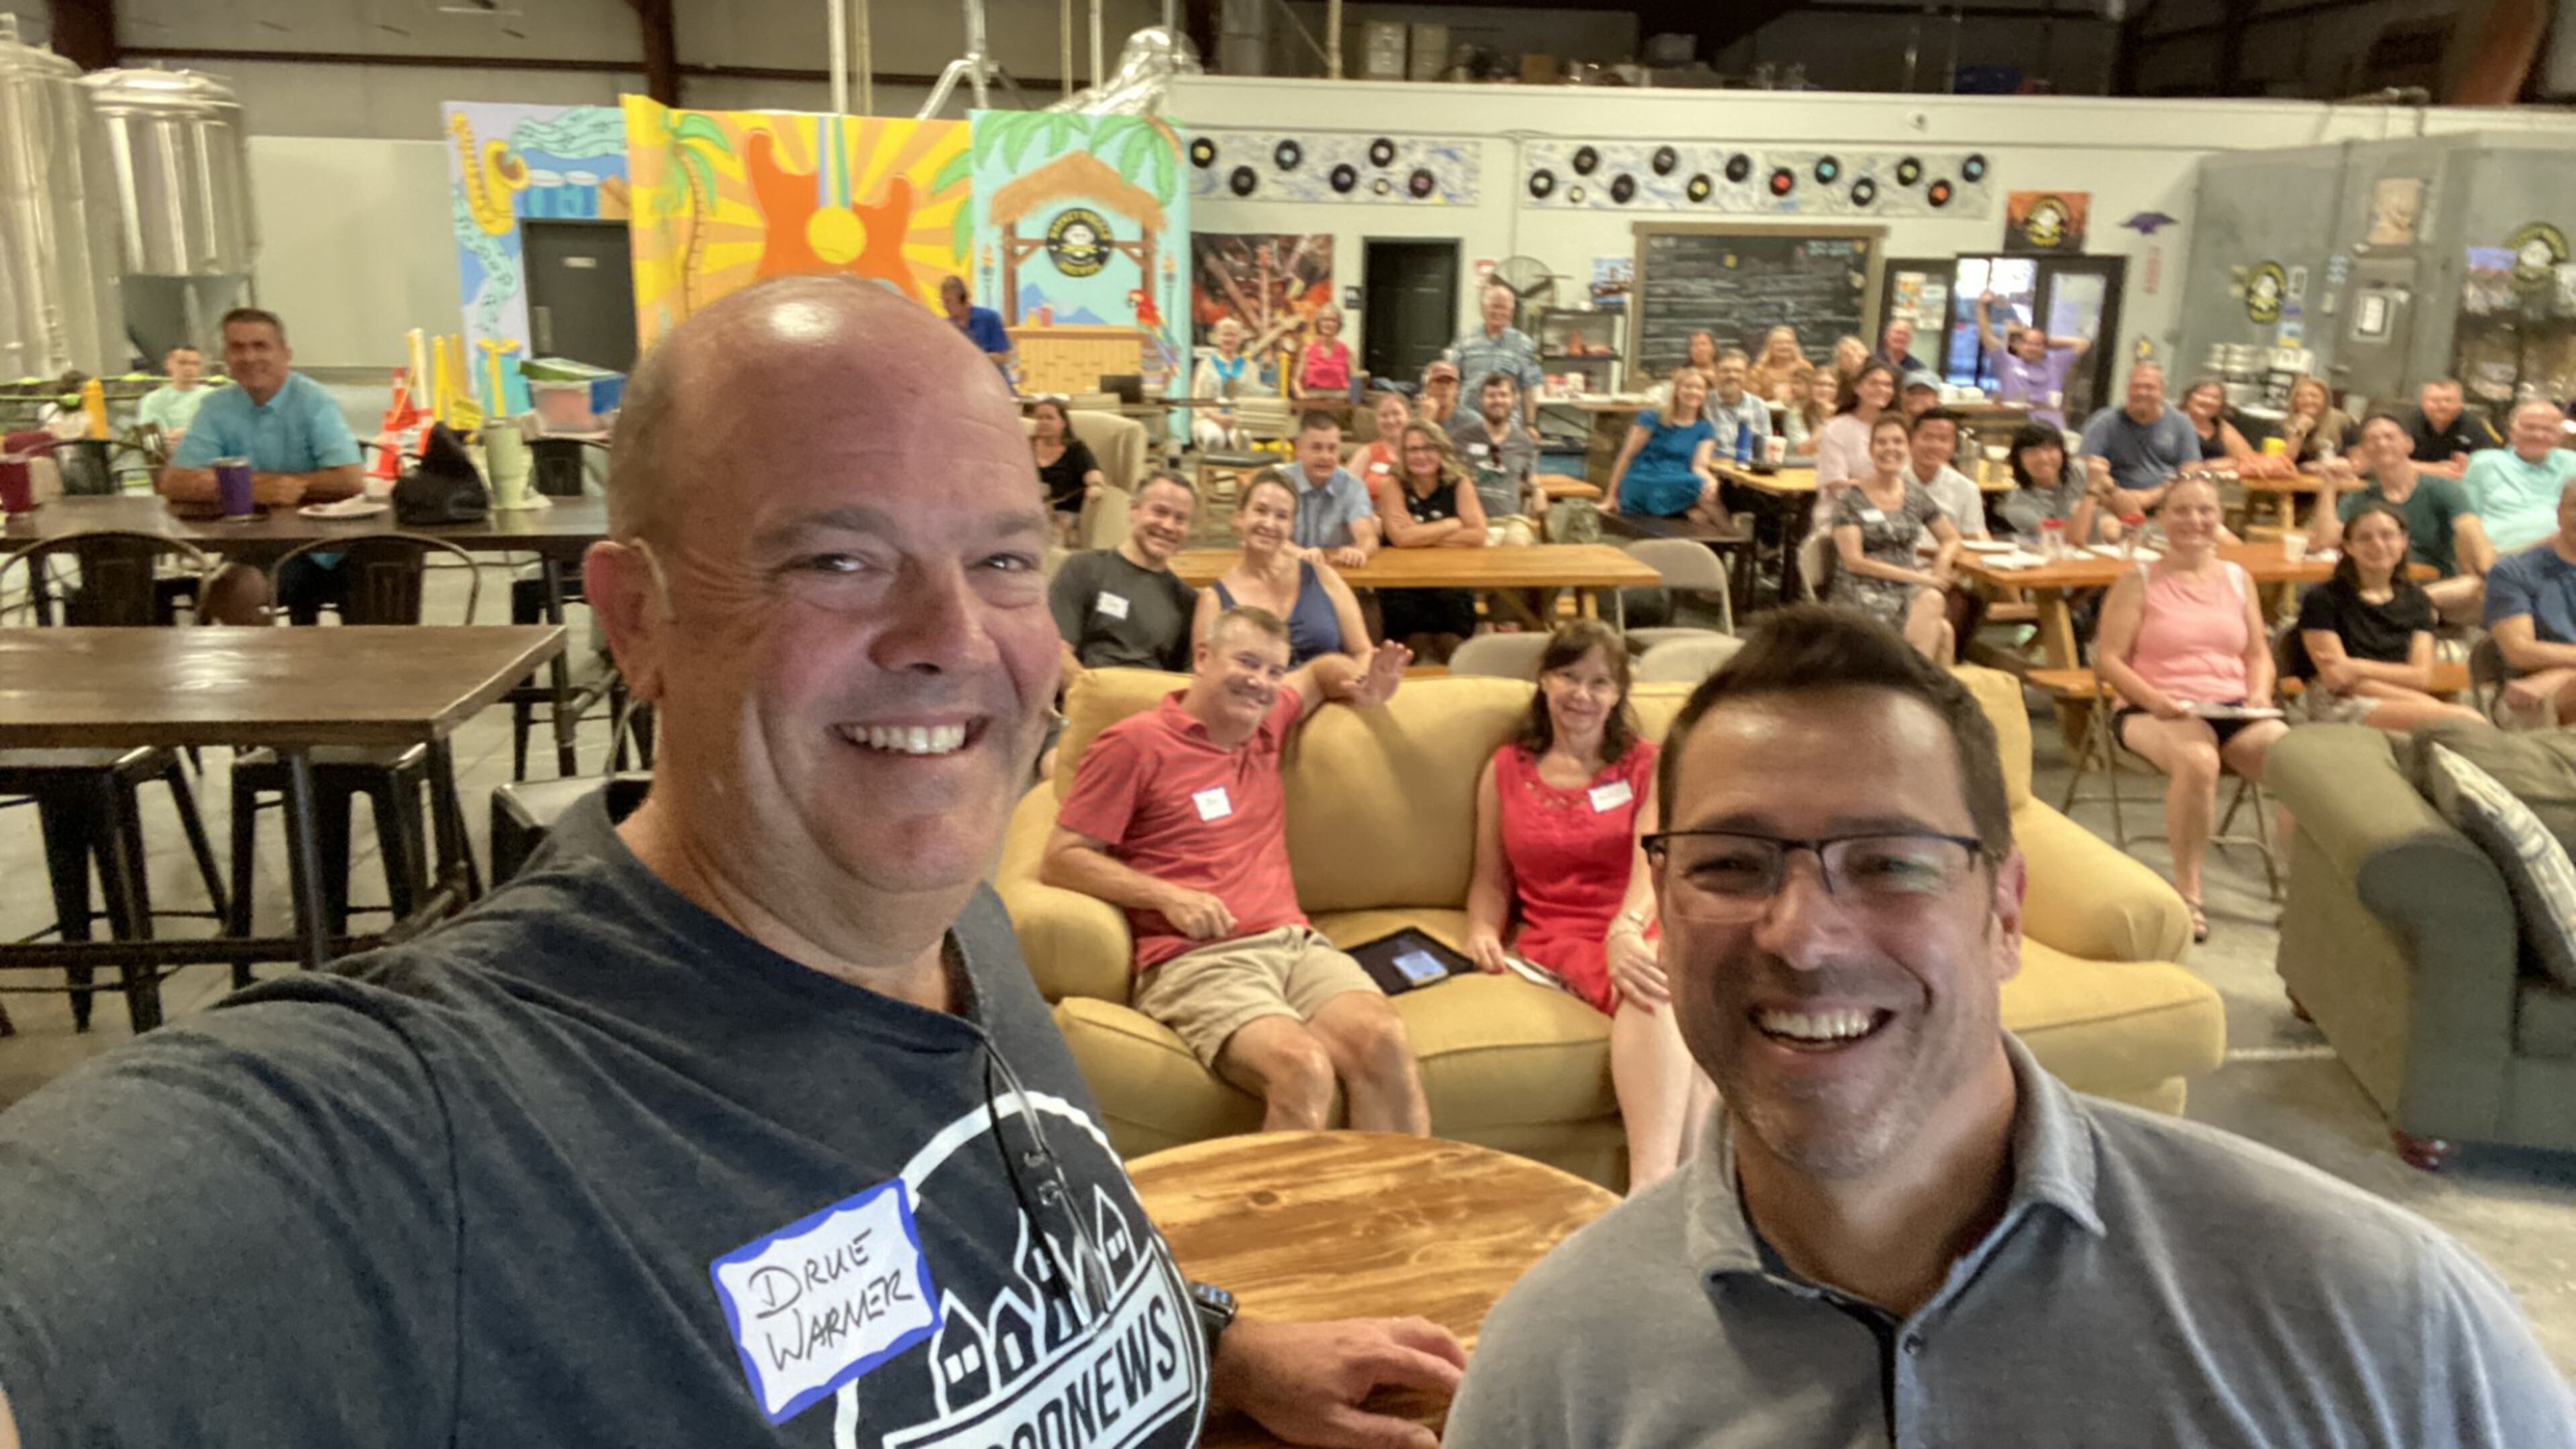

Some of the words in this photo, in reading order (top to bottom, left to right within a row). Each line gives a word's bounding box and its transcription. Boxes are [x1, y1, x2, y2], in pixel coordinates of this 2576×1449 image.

[749, 1228, 872, 1319] DRUE
[766, 1269, 915, 1371] WARNER
[985, 1295, 1177, 1449] DNEWS
